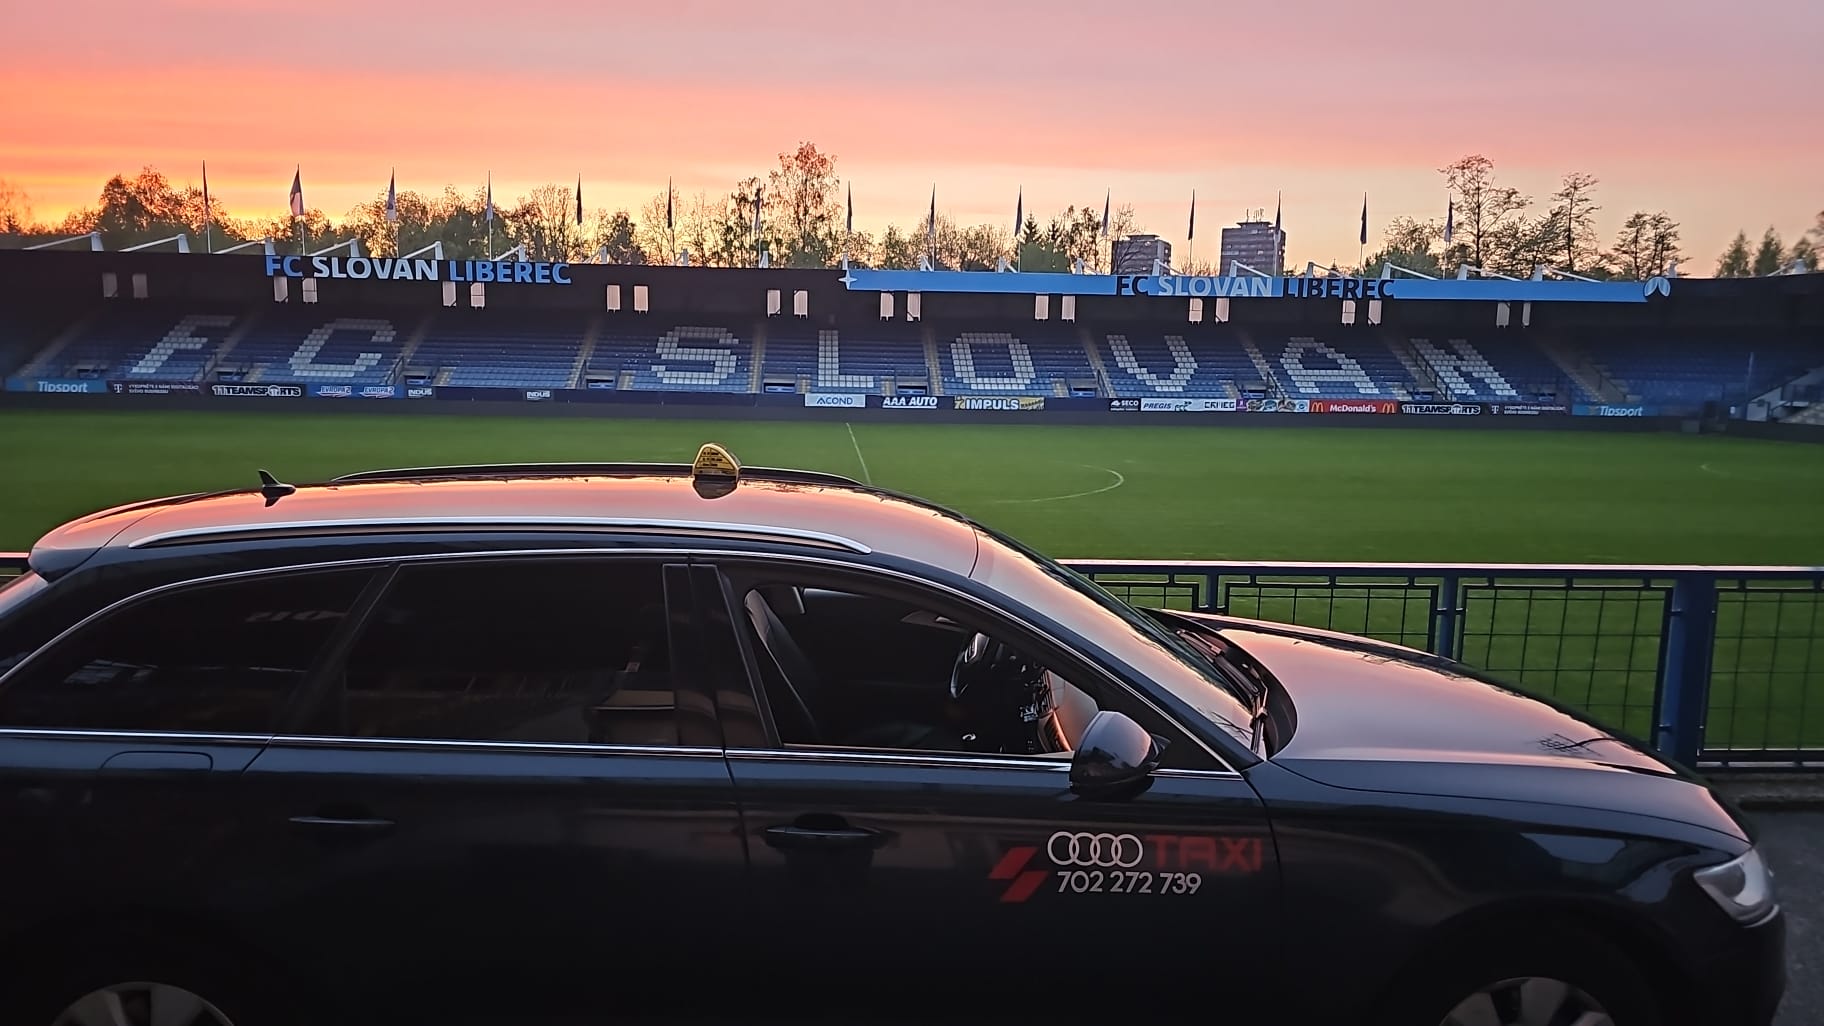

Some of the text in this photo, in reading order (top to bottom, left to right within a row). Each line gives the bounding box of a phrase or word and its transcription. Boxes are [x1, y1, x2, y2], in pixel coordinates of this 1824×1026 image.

[265, 255, 572, 284] FC SLOVAN LIBEREC
[1116, 275, 1395, 299] FC SLOVAN LIBEREC
[37, 380, 88, 393] Tipsport
[815, 396, 853, 406] ACOND
[882, 396, 937, 407] AAA AUTO
[965, 398, 1019, 410] IMPULS
[1329, 403, 1377, 413] McDonald's
[1600, 405, 1643, 417] Tipsport
[1146, 834, 1263, 872] TAXI
[1057, 870, 1202, 895] 702 272 739
